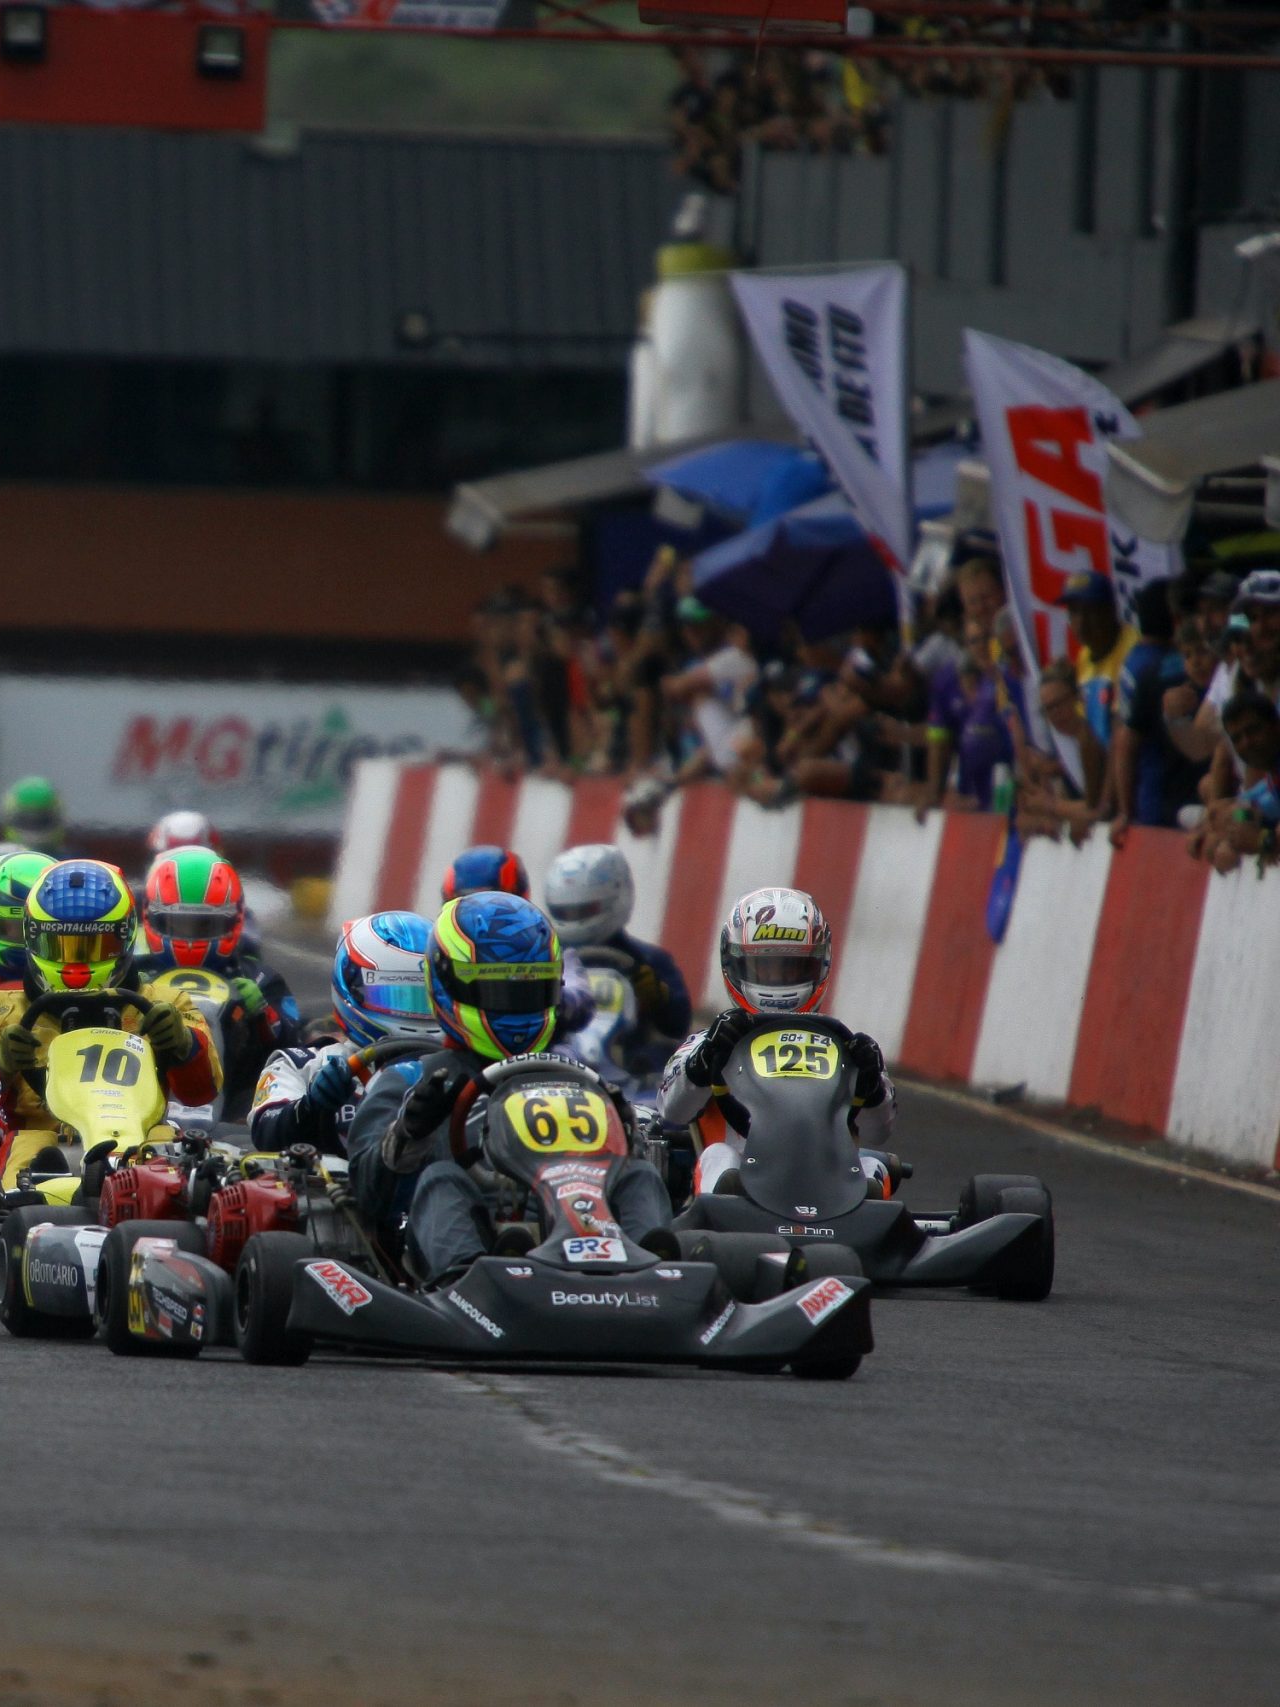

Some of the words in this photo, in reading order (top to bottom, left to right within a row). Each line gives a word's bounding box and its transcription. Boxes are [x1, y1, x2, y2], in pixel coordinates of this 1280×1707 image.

[780, 1033, 804, 1043] 60+
[810, 1034, 832, 1047] F4
[76, 1043, 142, 1088] 10
[758, 1044, 832, 1074] 125
[524, 1097, 599, 1146] 65
[447, 1290, 504, 1339] BANCOUROS
[551, 1291, 660, 1308] BeautyList
